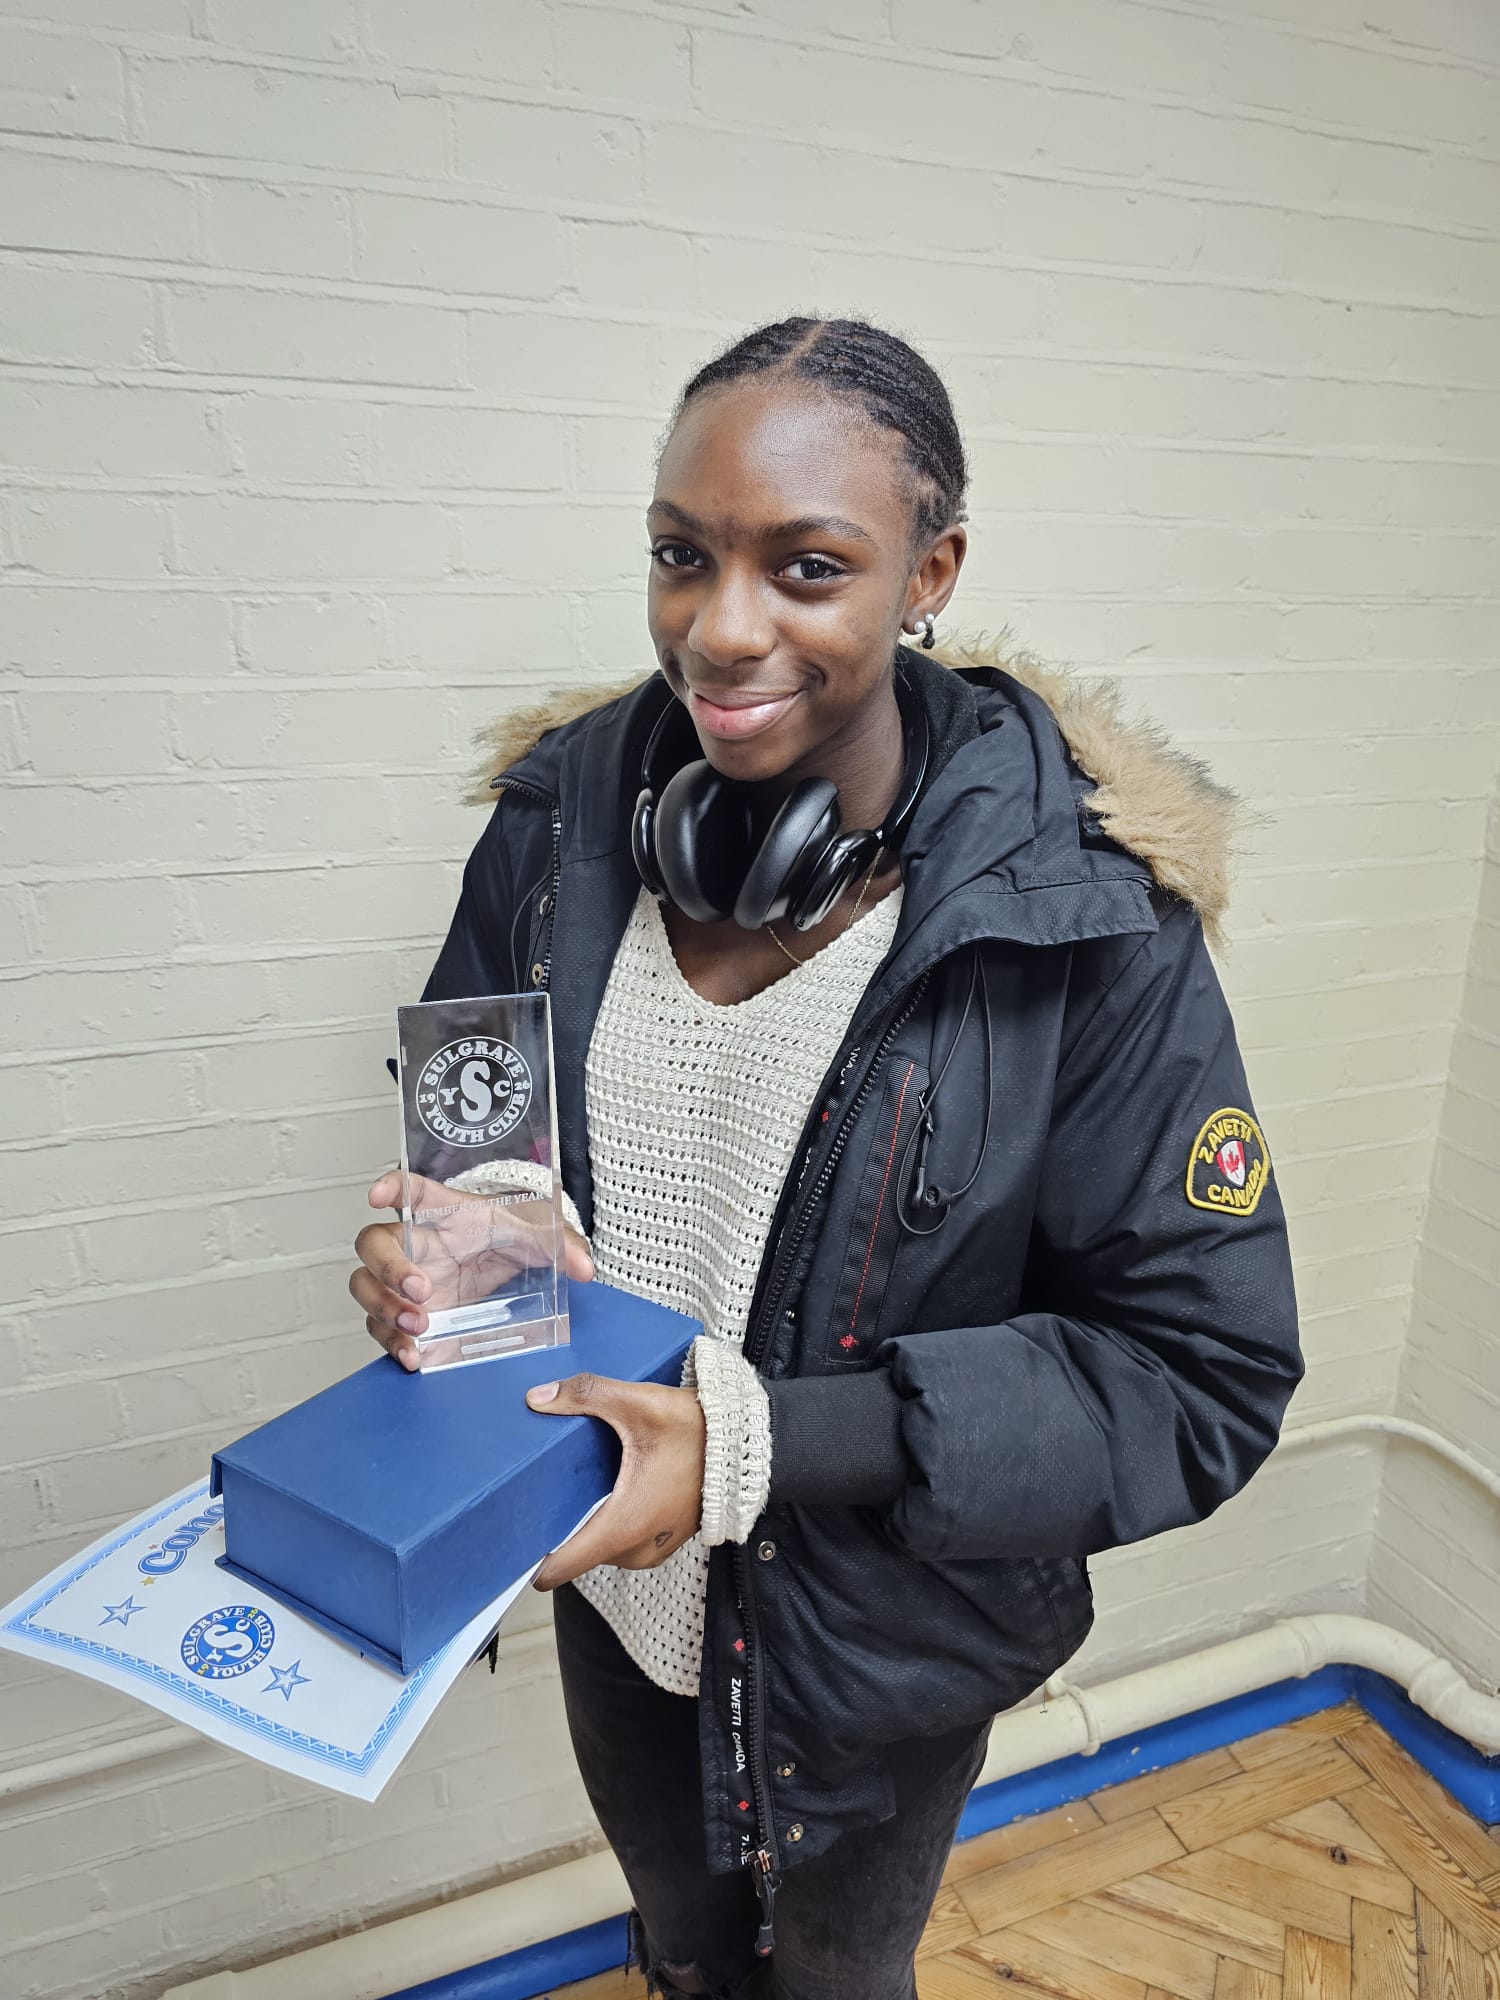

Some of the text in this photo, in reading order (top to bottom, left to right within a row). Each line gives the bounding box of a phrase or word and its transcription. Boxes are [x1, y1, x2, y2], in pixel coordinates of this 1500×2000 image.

[424, 1041, 524, 1086] SULGRAVE
[419, 1093, 436, 1103] 19
[425, 1093, 525, 1142] YOUTH CLUB
[1198, 1118, 1253, 1164] ZAVETTI
[415, 1191, 545, 1219] MEMBER OF THE YEAR
[1207, 1158, 1261, 1207] CANADA
[184, 1607, 245, 1665] SULGRAVE
[212, 1615, 272, 1677] YOUTH CLUB
[197, 1664, 209, 1676] 19
[731, 1677, 742, 1726] ZAVETTI
